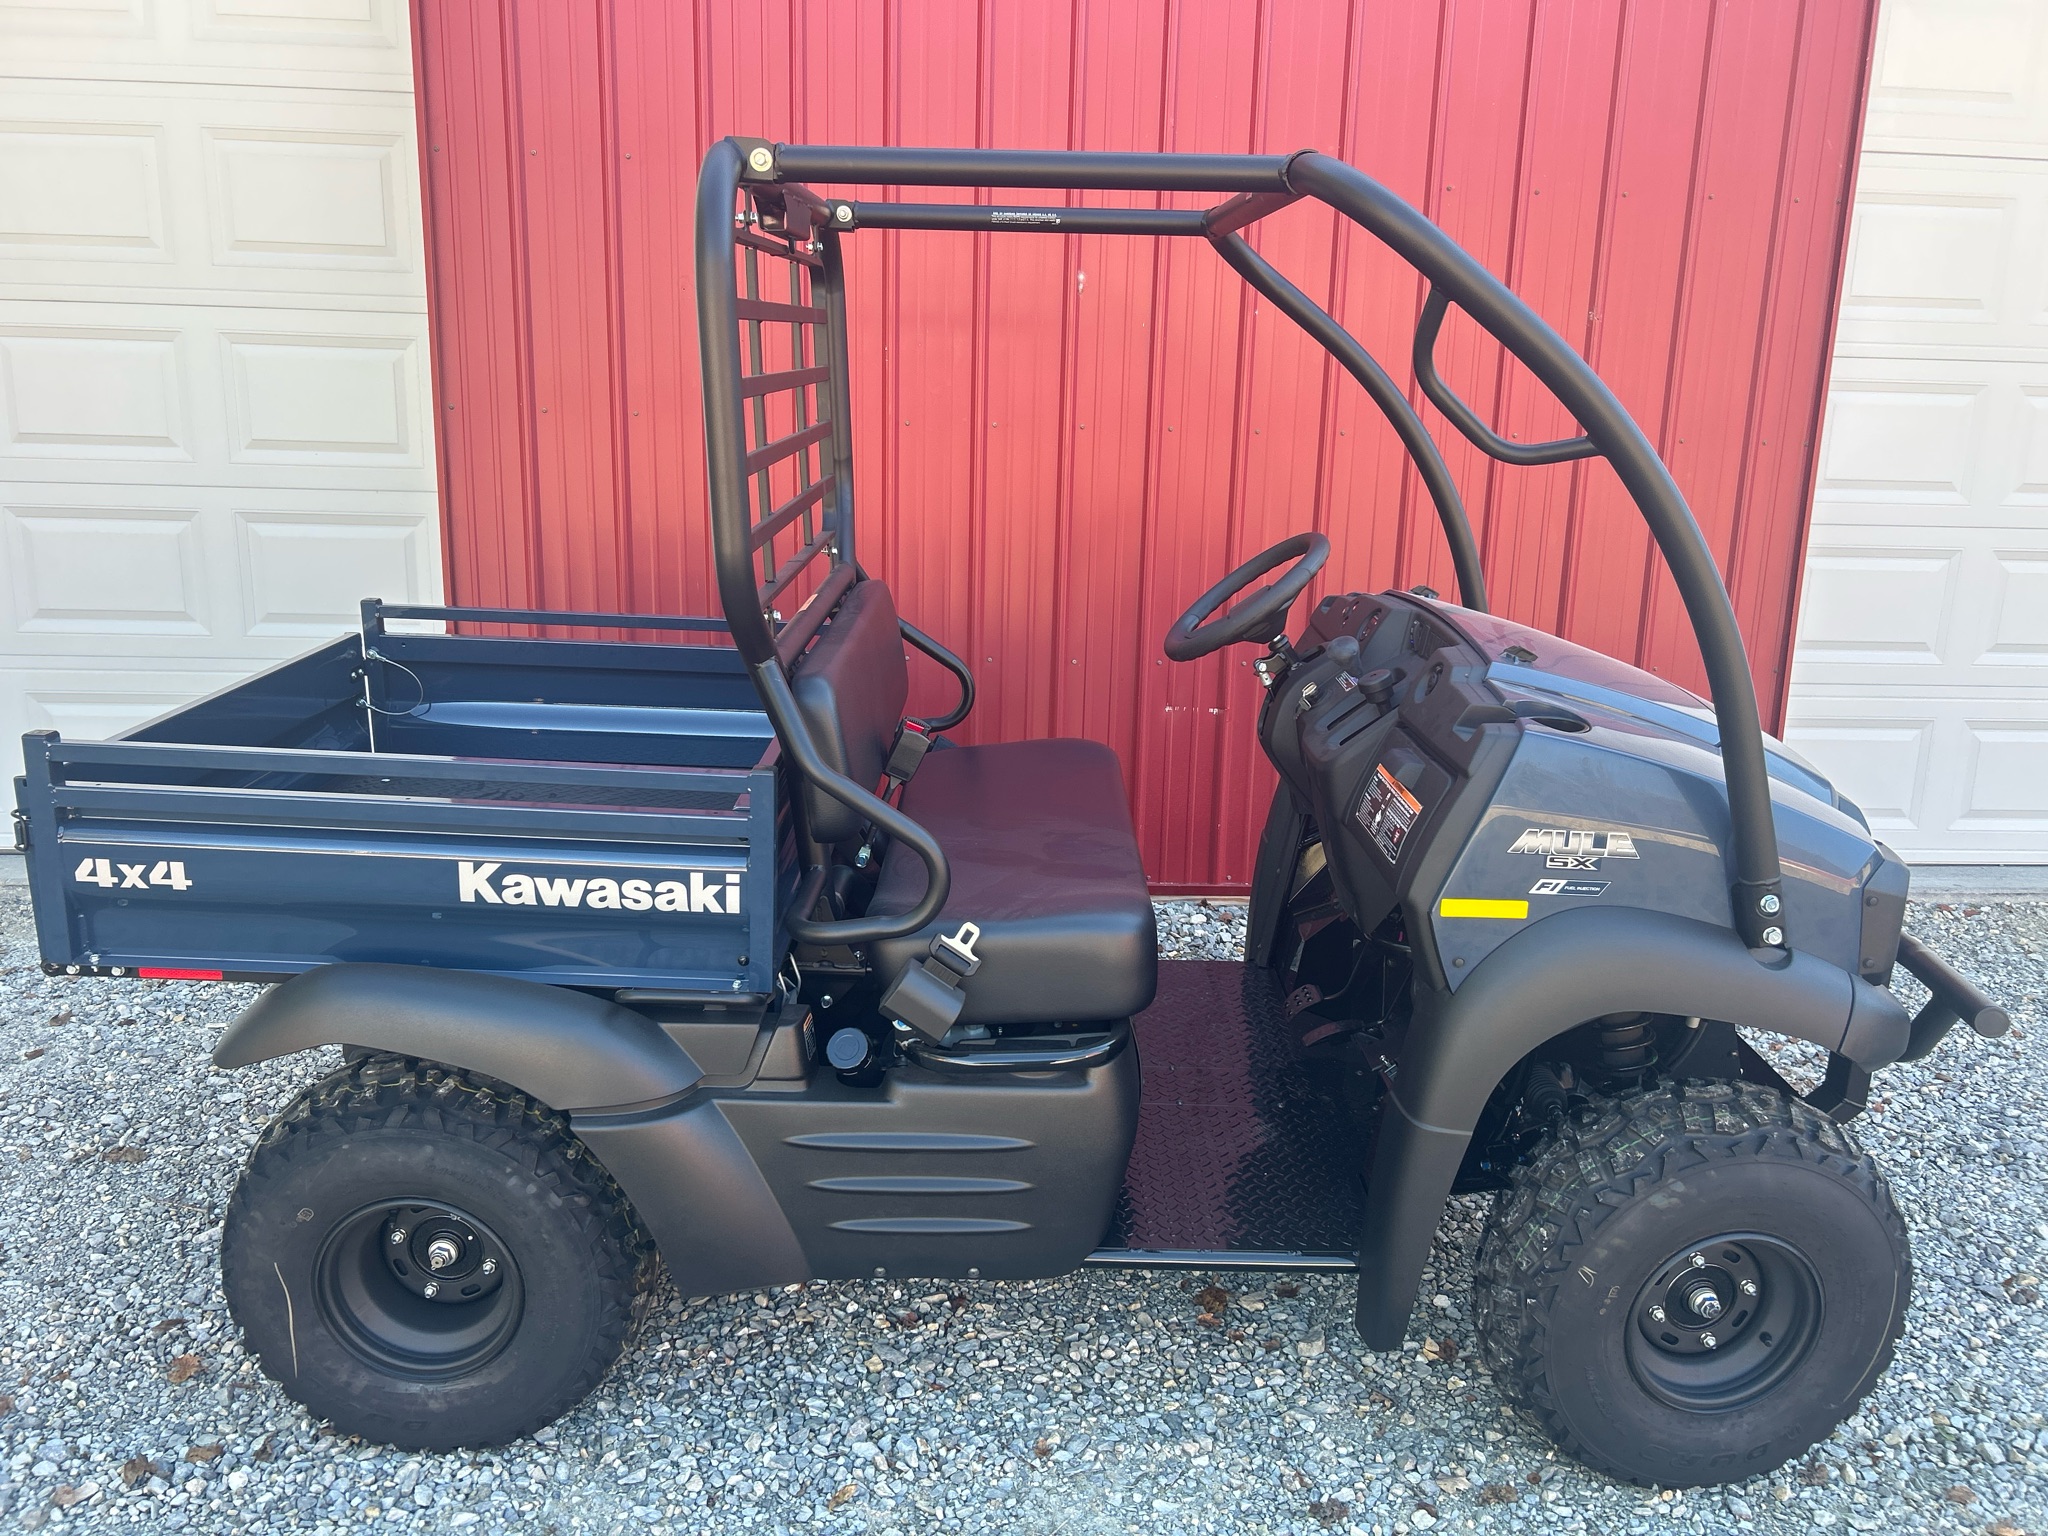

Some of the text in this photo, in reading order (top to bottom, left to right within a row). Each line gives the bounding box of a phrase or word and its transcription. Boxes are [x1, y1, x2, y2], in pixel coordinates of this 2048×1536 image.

[1507, 828, 1641, 859] MULE
[74, 858, 193, 891] 4x4
[1546, 856, 1600, 870] SX
[458, 861, 740, 914] Kawasaki
